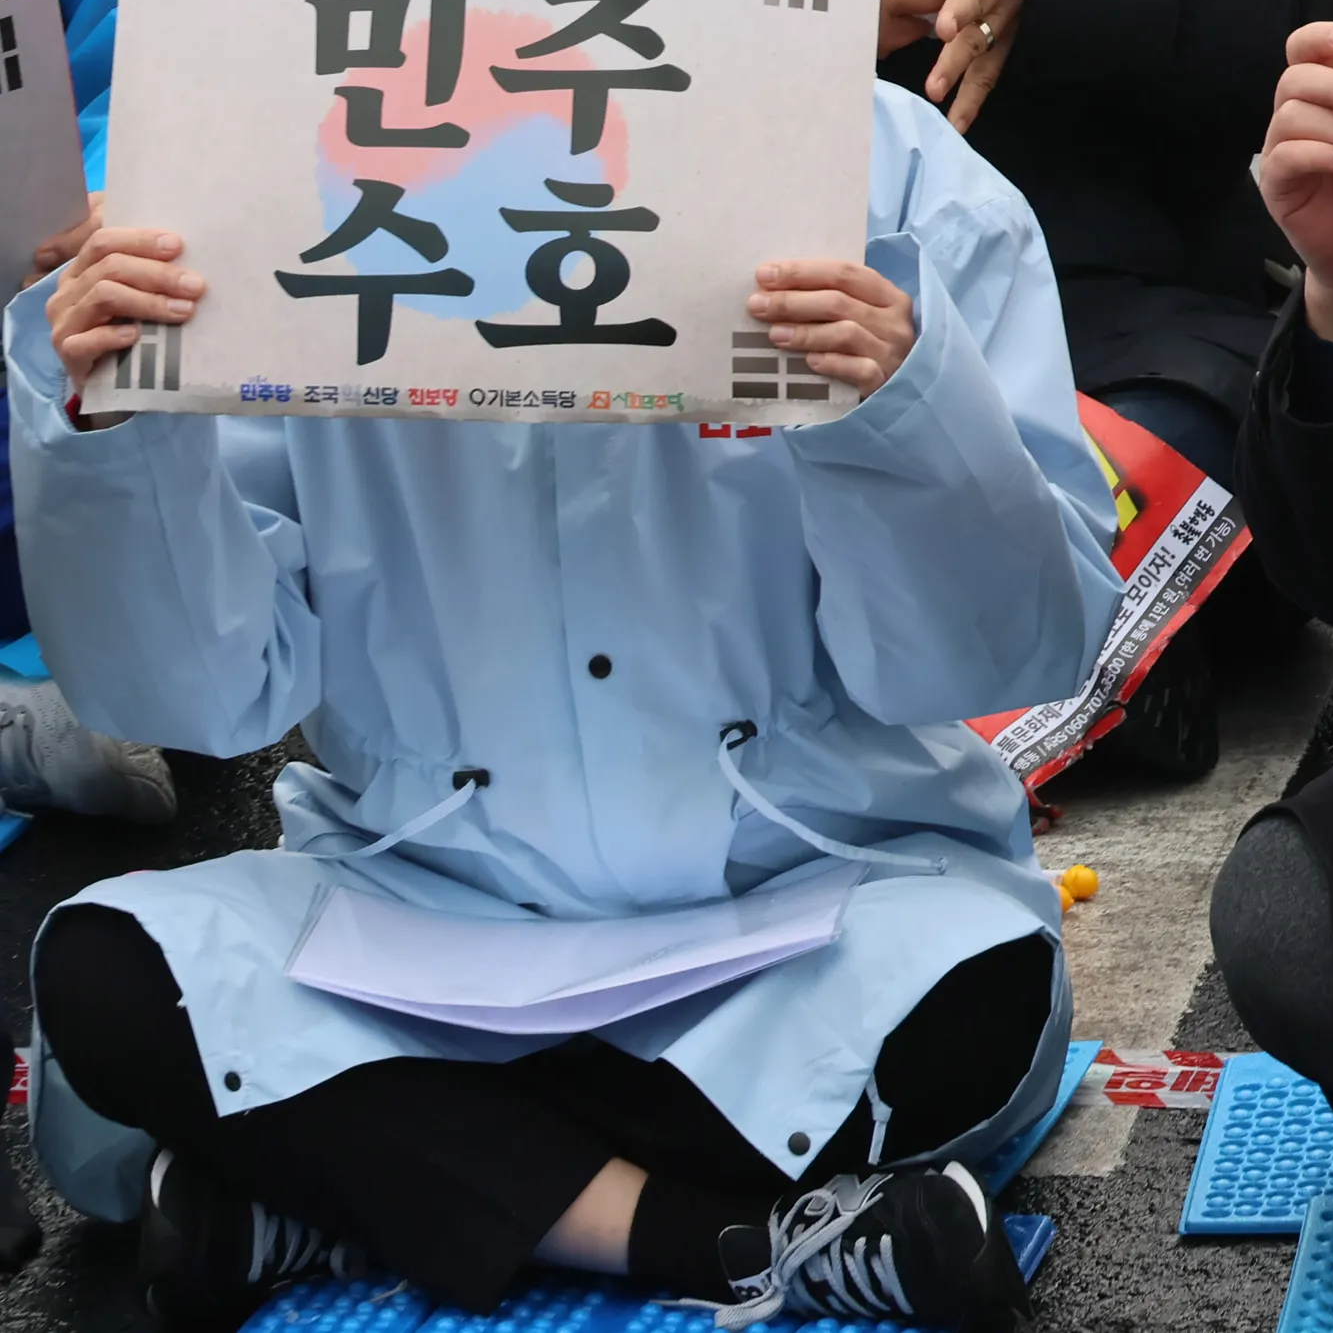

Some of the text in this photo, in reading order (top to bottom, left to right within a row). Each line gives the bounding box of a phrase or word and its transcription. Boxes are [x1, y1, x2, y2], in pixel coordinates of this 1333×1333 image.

[273, 177, 678, 366] 수호
[408, 387, 458, 407] 진보당
[1129, 546, 1176, 606] 모이자!
